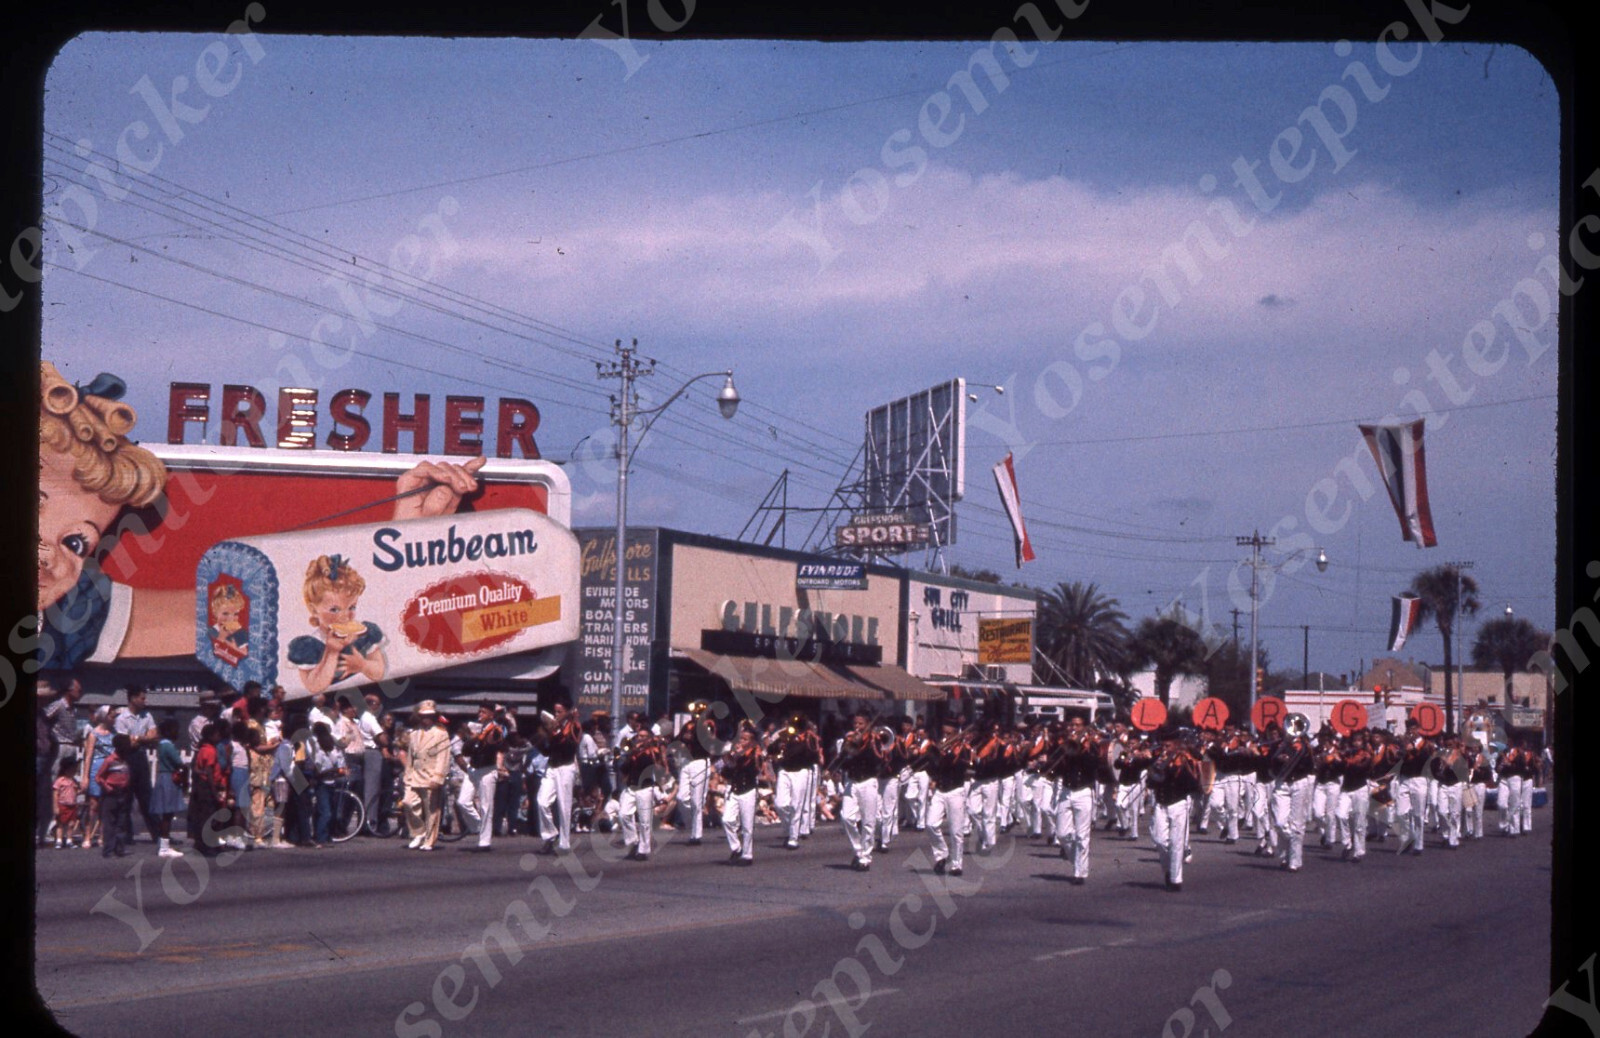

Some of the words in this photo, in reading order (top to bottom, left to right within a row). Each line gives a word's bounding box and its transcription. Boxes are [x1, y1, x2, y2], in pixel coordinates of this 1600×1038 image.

[168, 381, 542, 460] FRESHER
[842, 525, 916, 545] SPORT
[373, 525, 537, 571] Sunbeam
[580, 536, 652, 580] Gulfsore
[610, 567, 651, 581] SLLS
[800, 564, 860, 577] EVINRUDE
[585, 586, 640, 597] EVINRDE
[418, 593, 477, 617] Premium
[479, 582, 523, 606] Quality
[600, 598, 649, 609] MOORS
[480, 609, 528, 632] White
[585, 610, 635, 621] BOAS
[584, 622, 649, 633] TRAIERS
[584, 671, 625, 682] GUN
[583, 683, 649, 696] AMMITION
